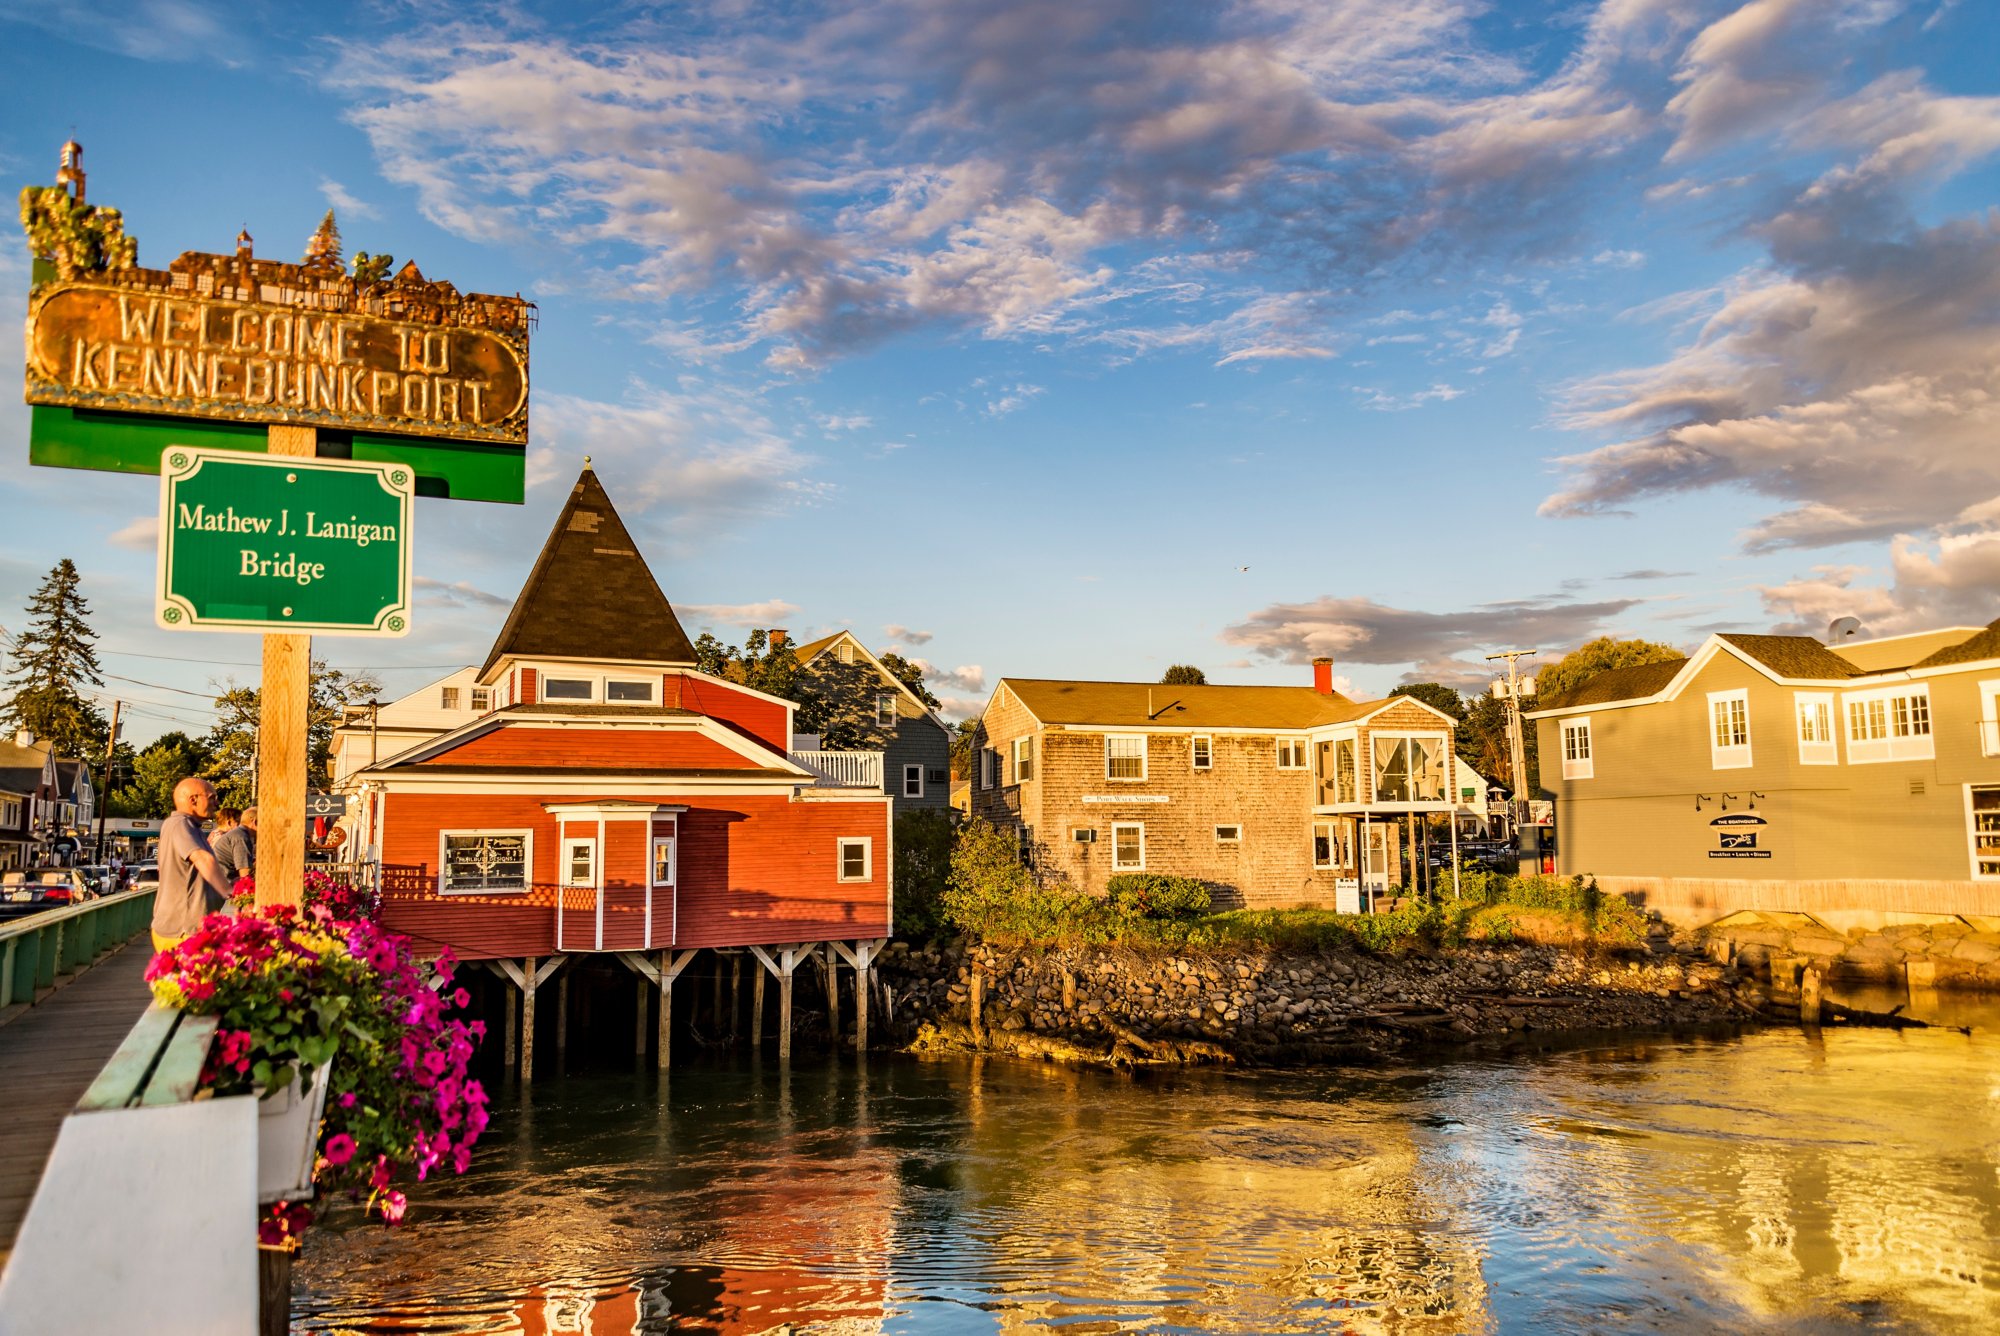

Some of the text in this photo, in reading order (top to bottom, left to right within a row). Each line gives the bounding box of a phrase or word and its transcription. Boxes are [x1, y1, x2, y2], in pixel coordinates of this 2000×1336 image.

[119, 295, 451, 375] WELCOME TO
[71, 337, 492, 424] KENNEBUNKPORT
[178, 503, 397, 547] Mathew J. Lanigan
[239, 549, 325, 586] Bridge
